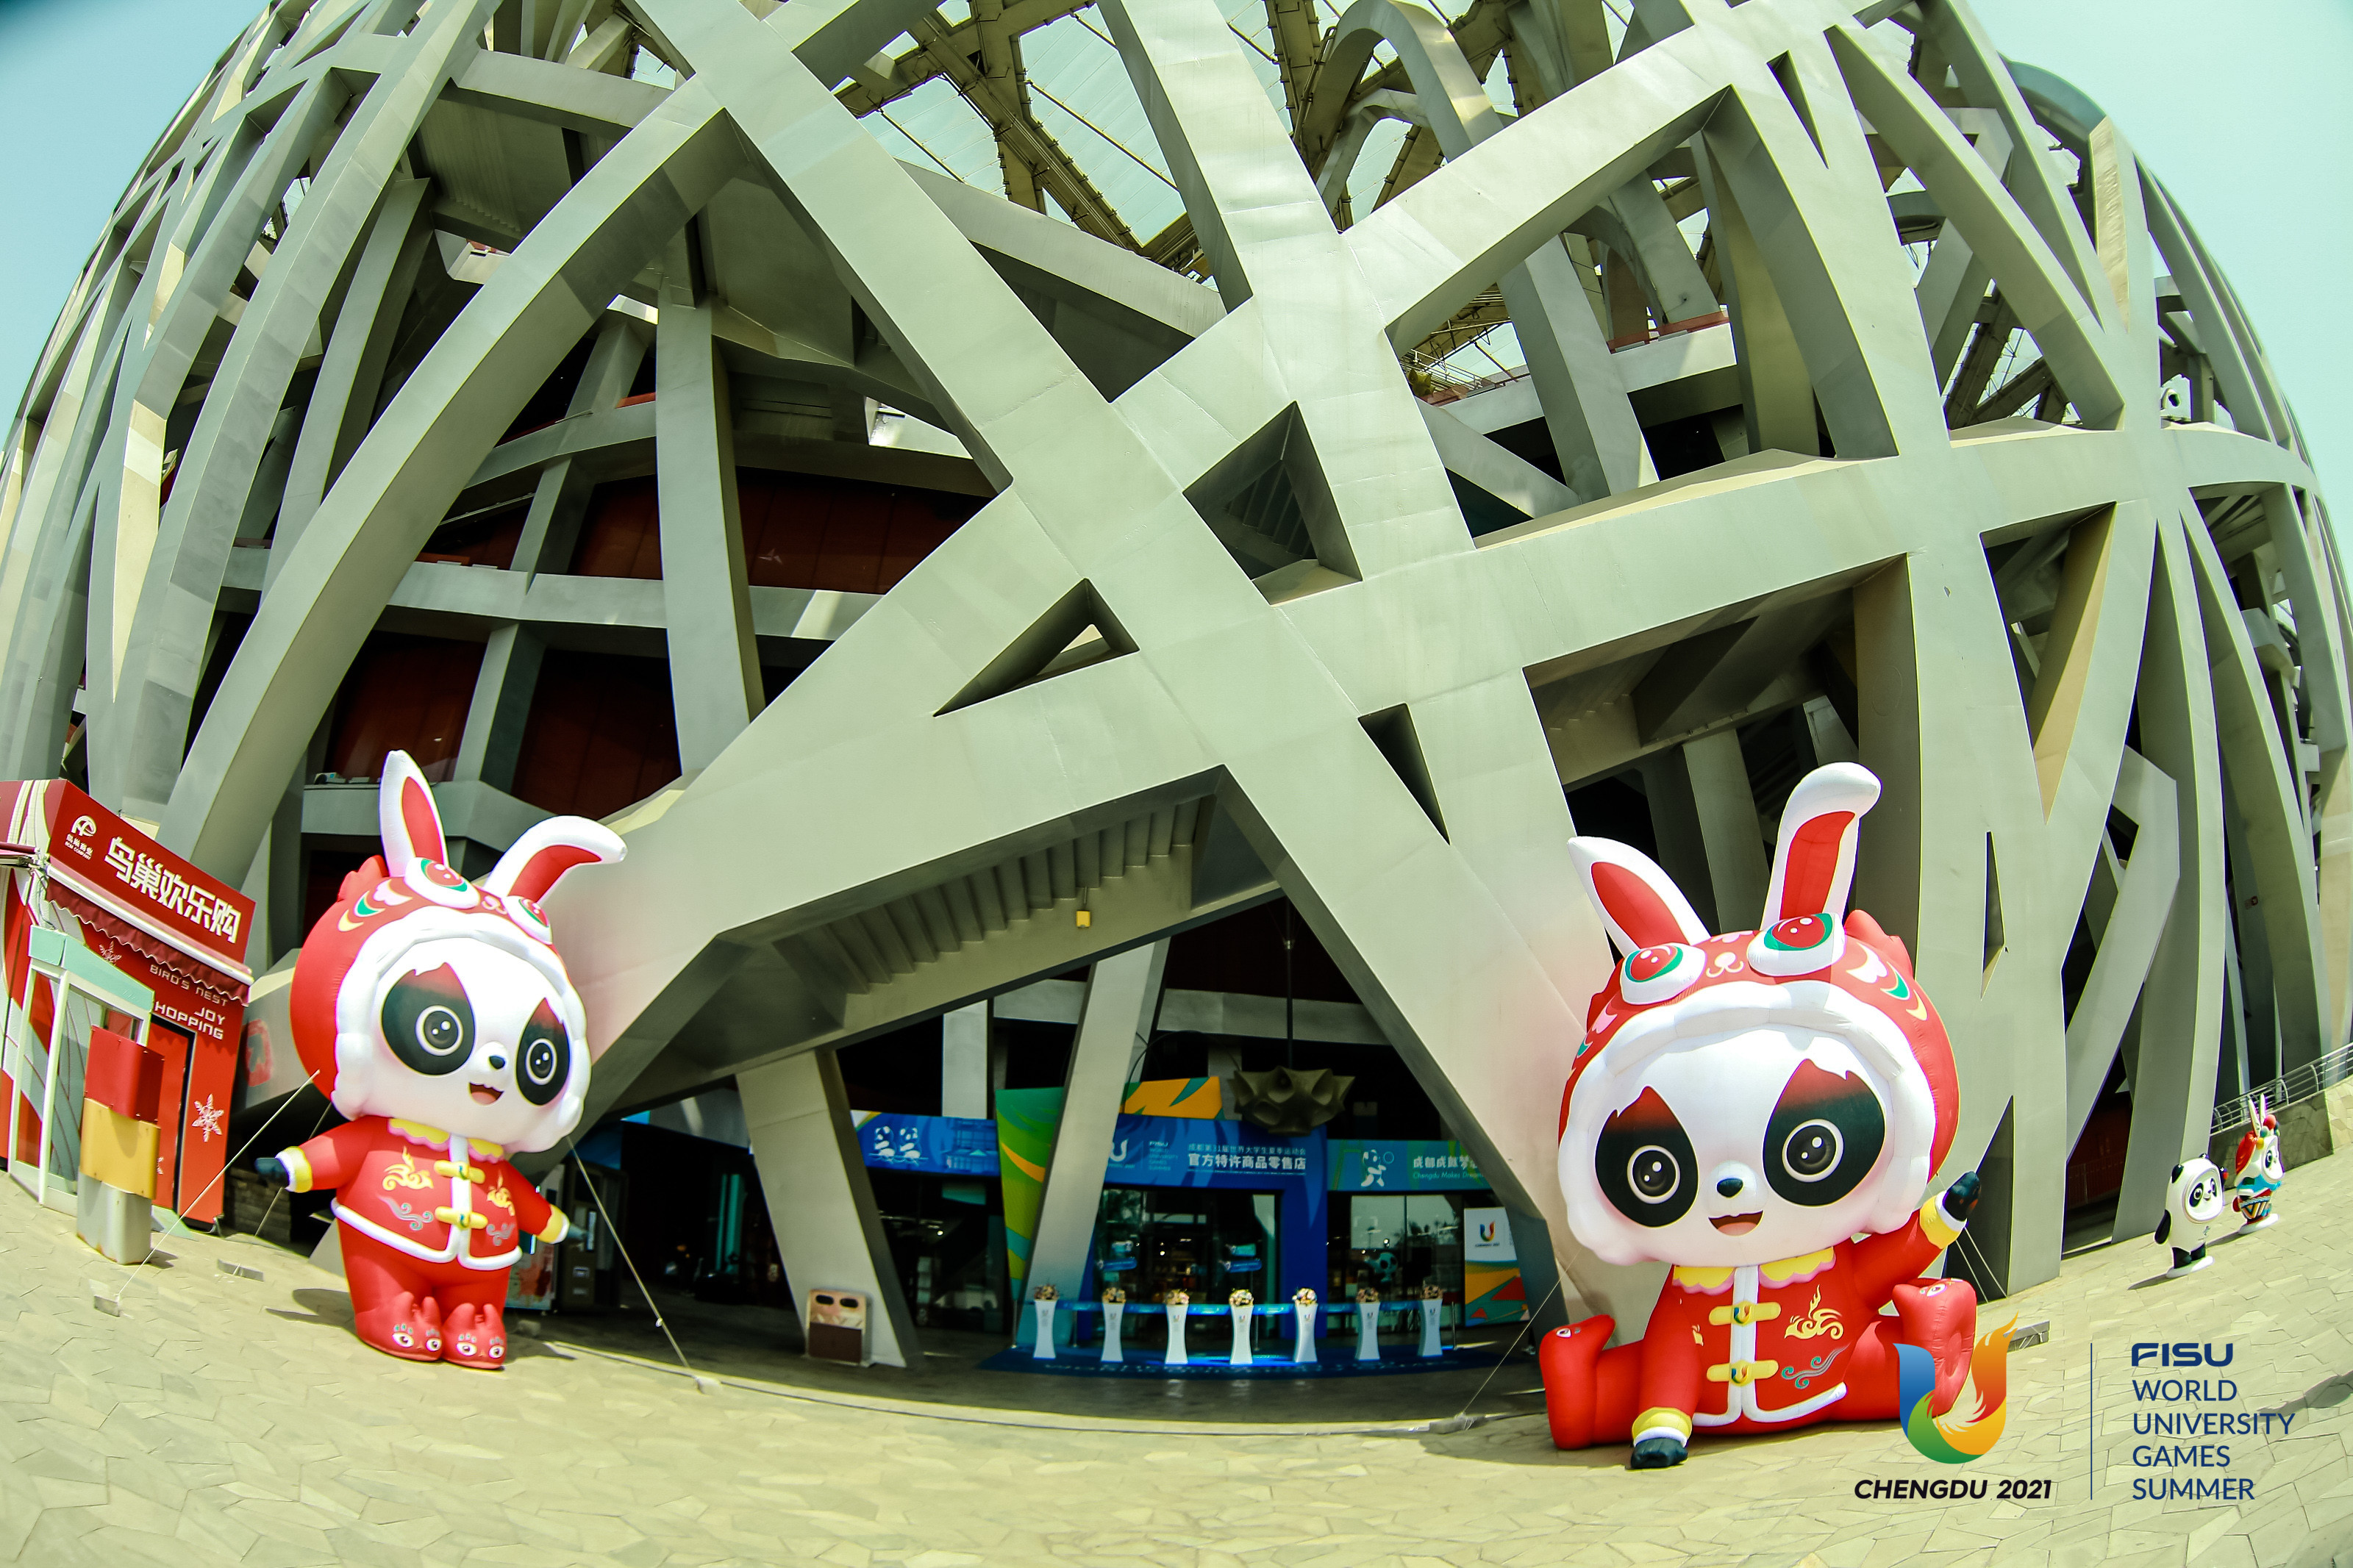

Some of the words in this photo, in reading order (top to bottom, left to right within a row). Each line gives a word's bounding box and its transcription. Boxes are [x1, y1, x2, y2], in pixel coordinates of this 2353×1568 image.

[104, 836, 241, 944] 鸟巢欢乐购
[149, 964, 190, 990] BIRD'S
[195, 987, 228, 1006] NEST
[154, 1000, 224, 1040] HOPPING
[193, 1006, 226, 1025] JOY
[1188, 1153, 1307, 1170] 官方特许商品零售店
